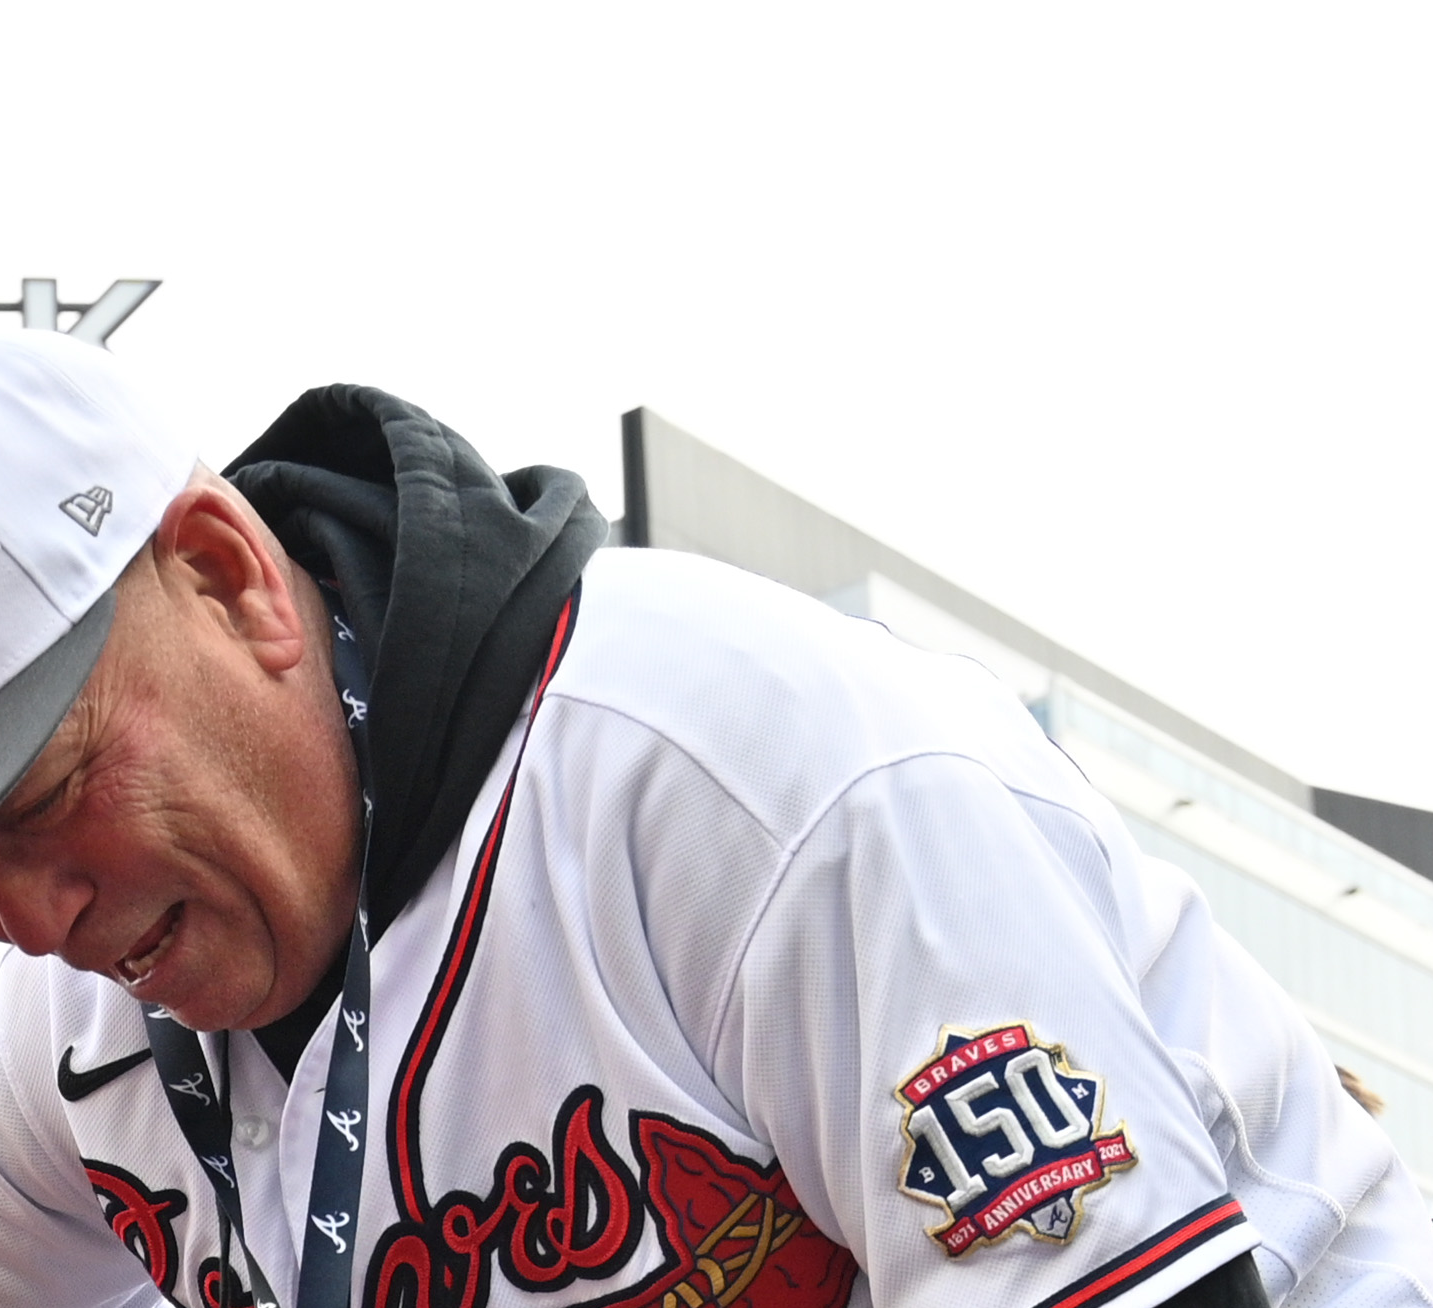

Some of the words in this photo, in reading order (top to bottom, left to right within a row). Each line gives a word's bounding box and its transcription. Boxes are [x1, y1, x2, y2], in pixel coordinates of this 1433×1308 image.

[914, 1031, 1016, 1095] BRAVES
[907, 1047, 1092, 1214] 150
[1098, 1145, 1126, 1162] 2021
[982, 1158, 1096, 1231] ANNIVERSARY
[946, 1222, 976, 1249] 1871
